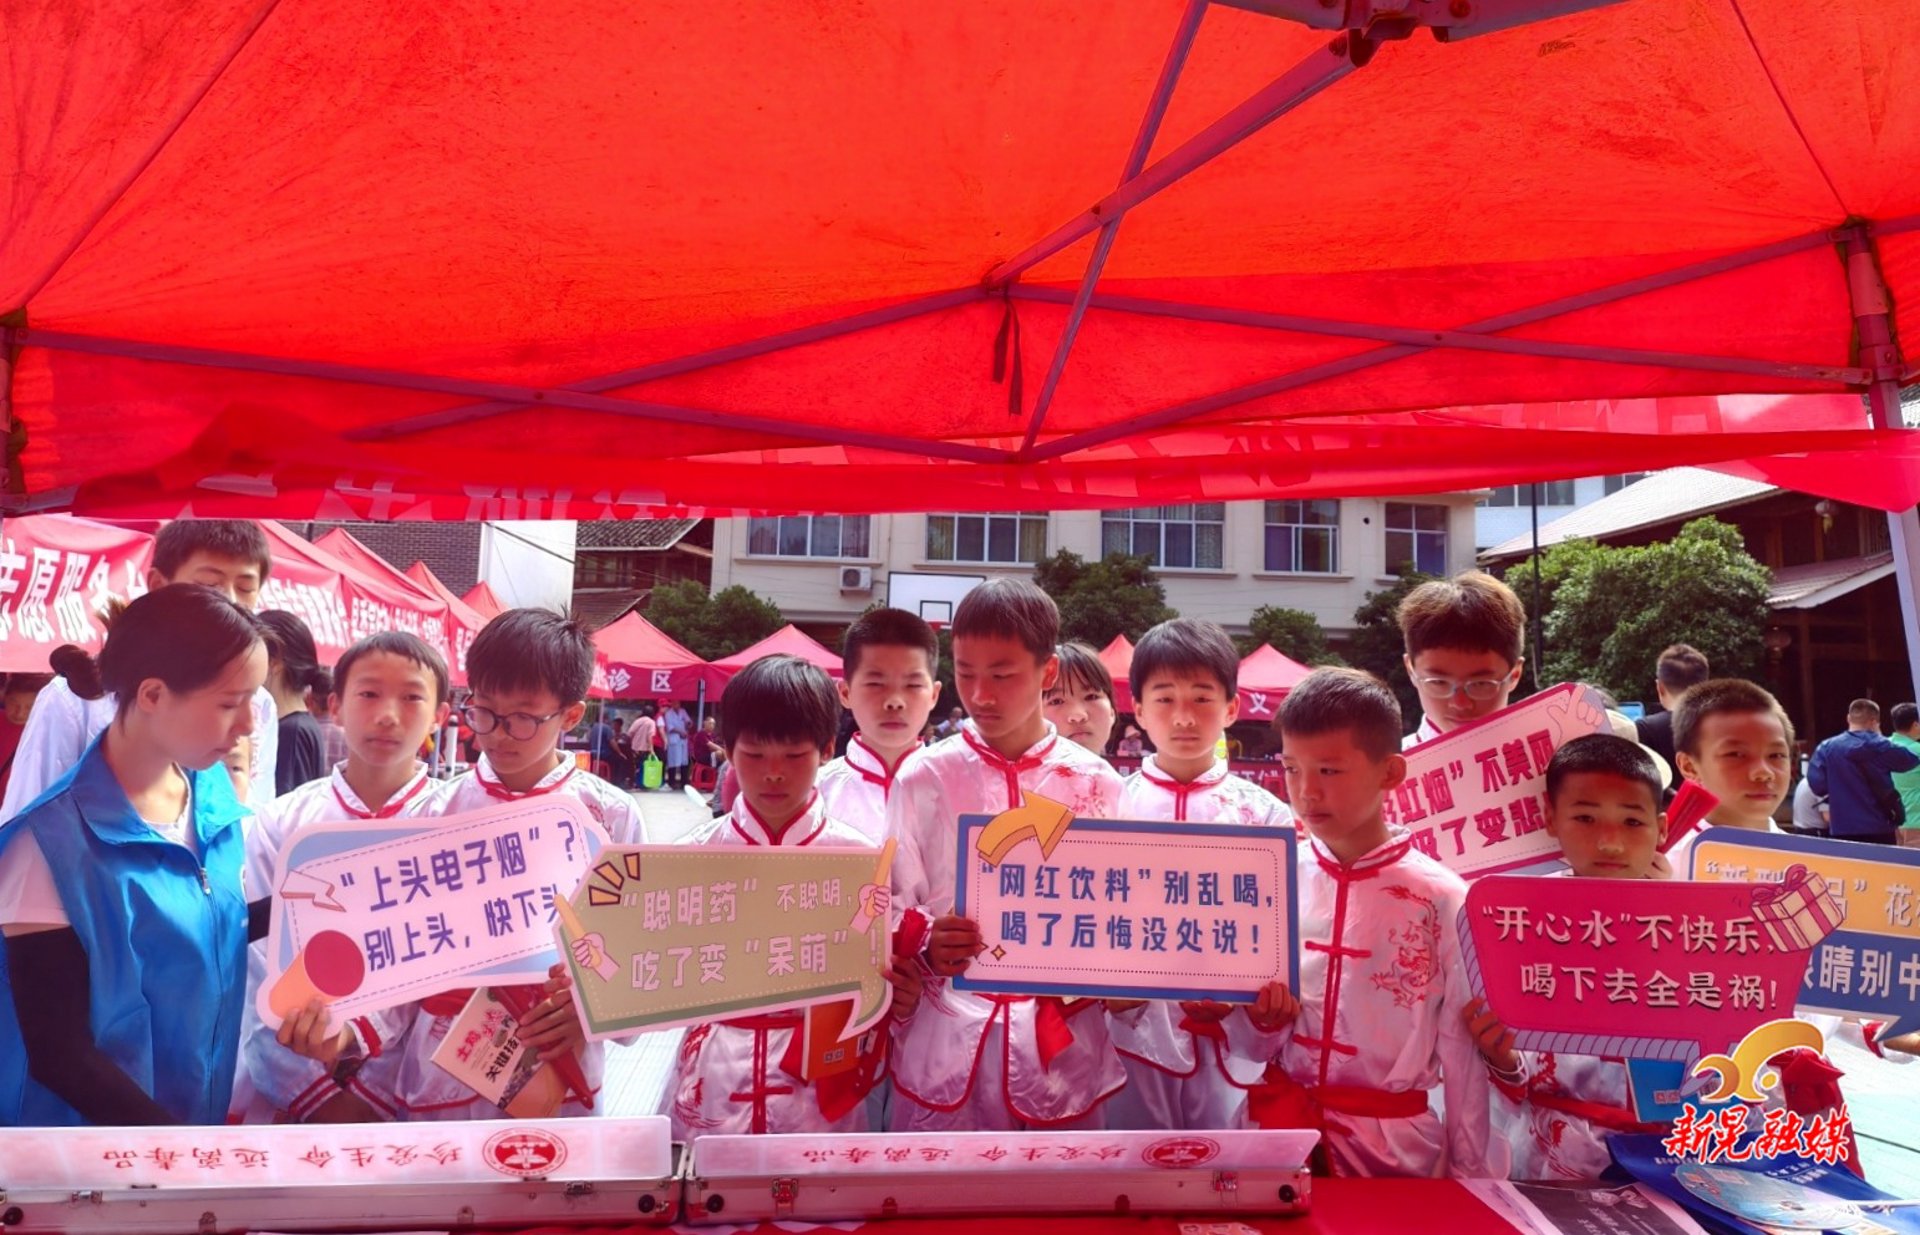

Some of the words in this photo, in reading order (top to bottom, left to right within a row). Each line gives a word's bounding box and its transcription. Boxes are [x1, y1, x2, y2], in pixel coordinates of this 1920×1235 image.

[1249, 692, 1271, 715] 义
[1409, 791, 1549, 862] 吸了变悲
[1000, 910, 1261, 955] 喝了后悔没处说！
[1804, 944, 1920, 1002] 睛别中
[1520, 963, 1778, 1011] 喝下去全是祸！
[102, 1147, 271, 1171] 远离毒品
[298, 1141, 463, 1168] 珍爱生命
[800, 1146, 953, 1166] 远离毒品
[976, 1144, 1128, 1165] 珍爱生命
